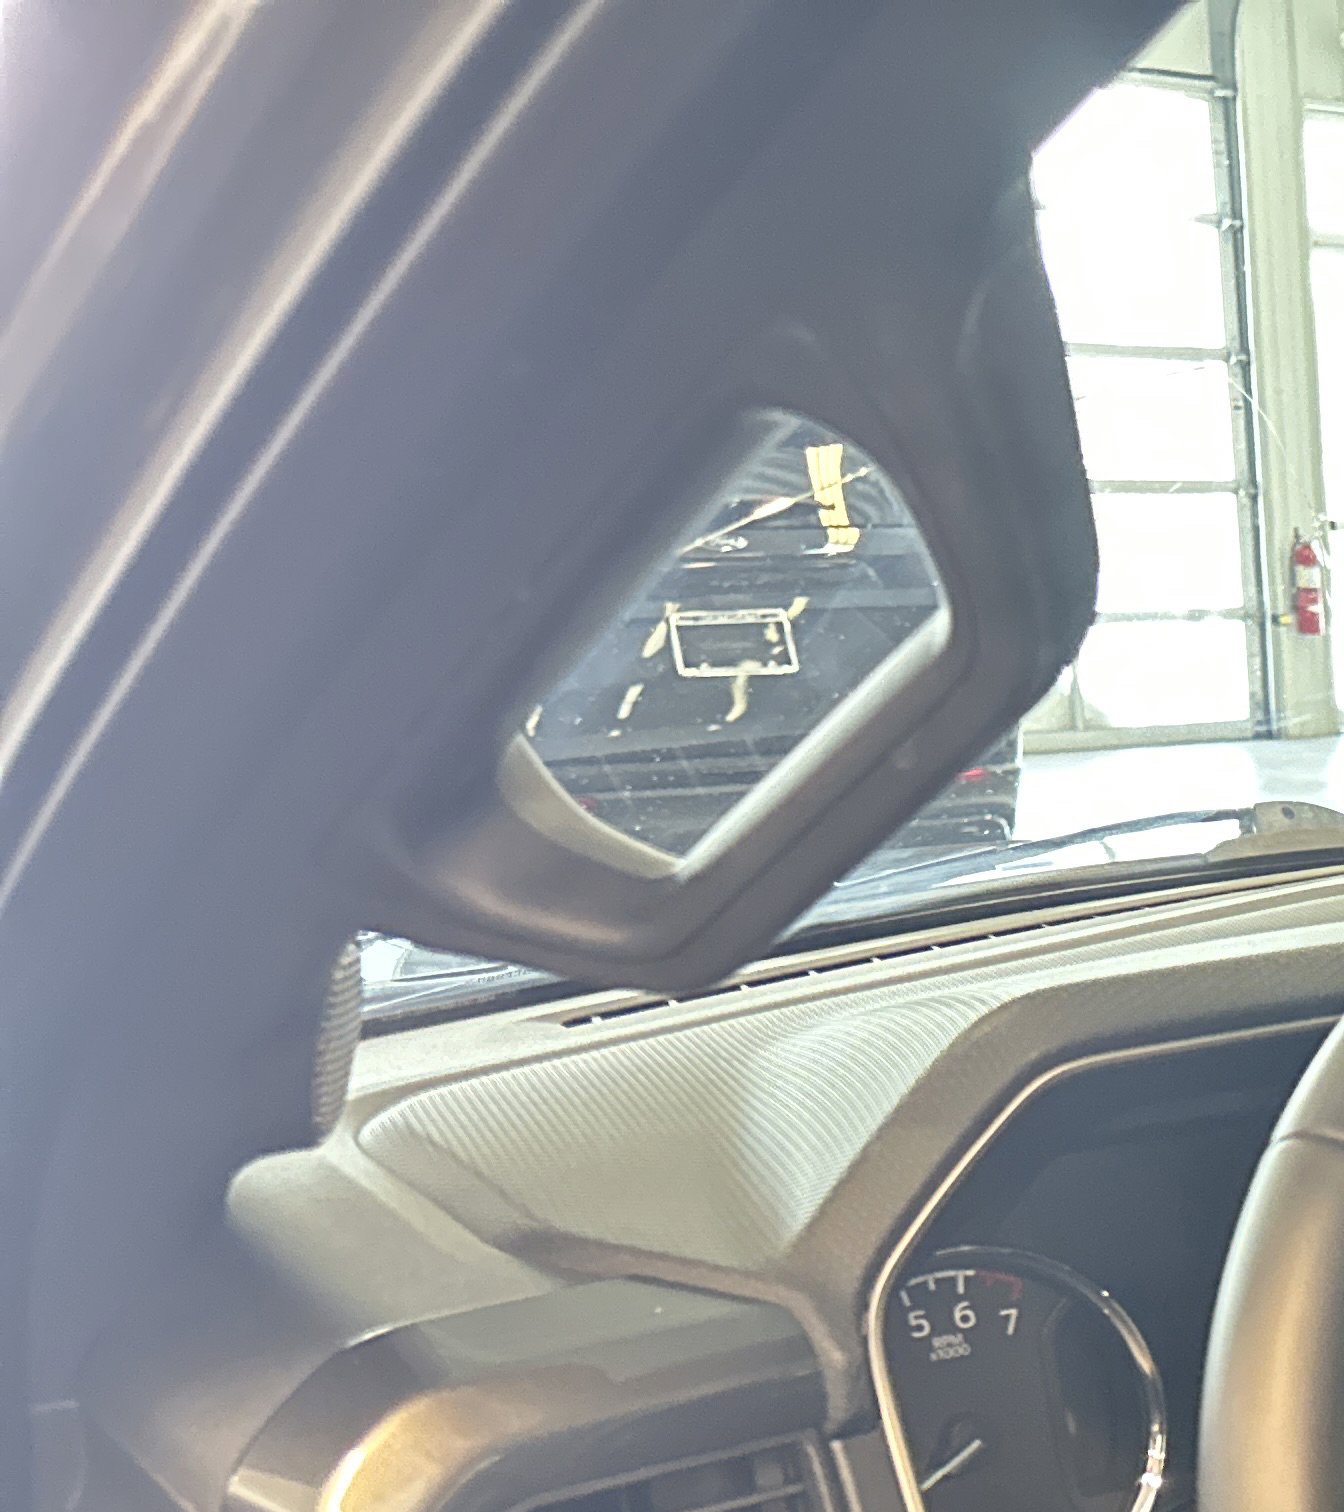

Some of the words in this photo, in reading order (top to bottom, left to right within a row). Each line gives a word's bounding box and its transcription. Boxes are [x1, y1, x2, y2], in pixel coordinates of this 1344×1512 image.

[906, 1309, 931, 1338] 5
[953, 1301, 976, 1328] 6
[999, 1308, 1018, 1335] 7
[931, 1333, 963, 1348] RPM
